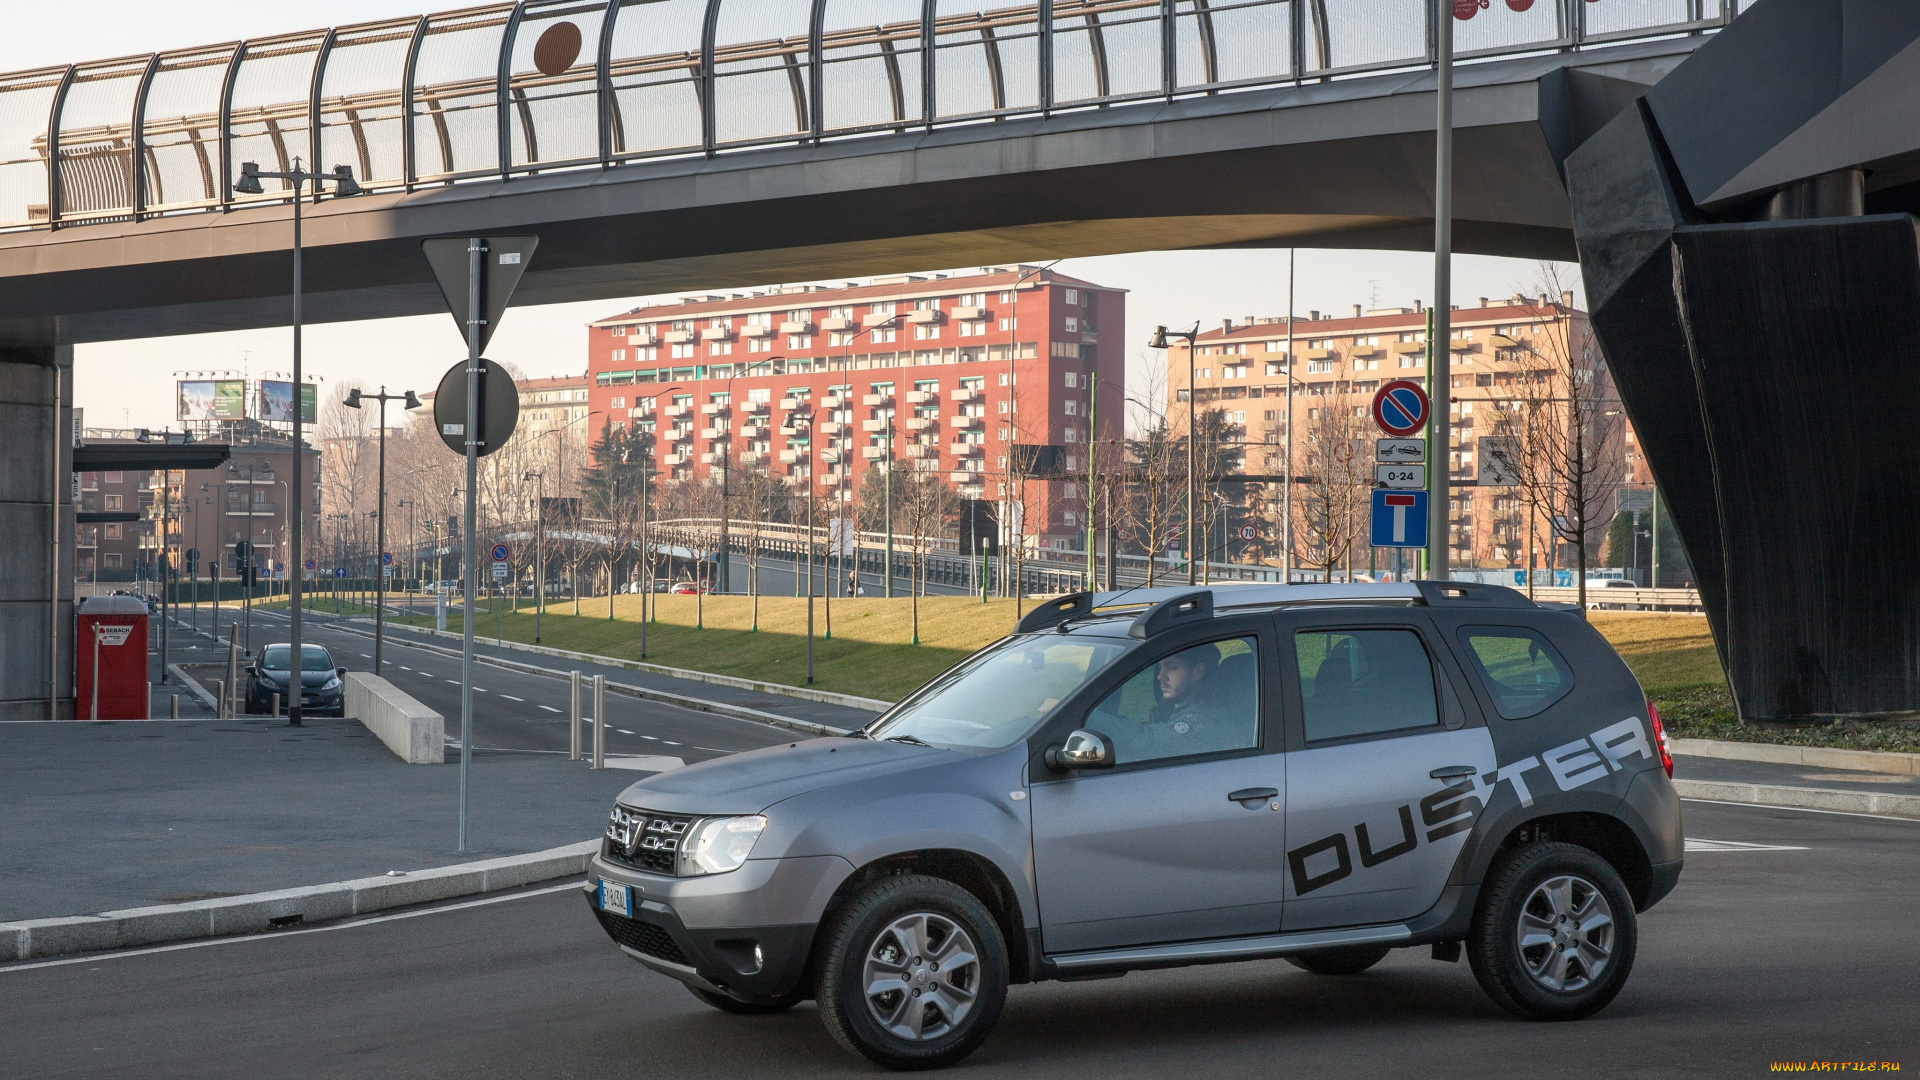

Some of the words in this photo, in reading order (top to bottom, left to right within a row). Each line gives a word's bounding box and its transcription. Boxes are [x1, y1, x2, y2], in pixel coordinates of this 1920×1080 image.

[1388, 471, 1414, 481] 0-24
[1244, 528, 1254, 538] 70
[1287, 716, 1652, 897] DUSTER
